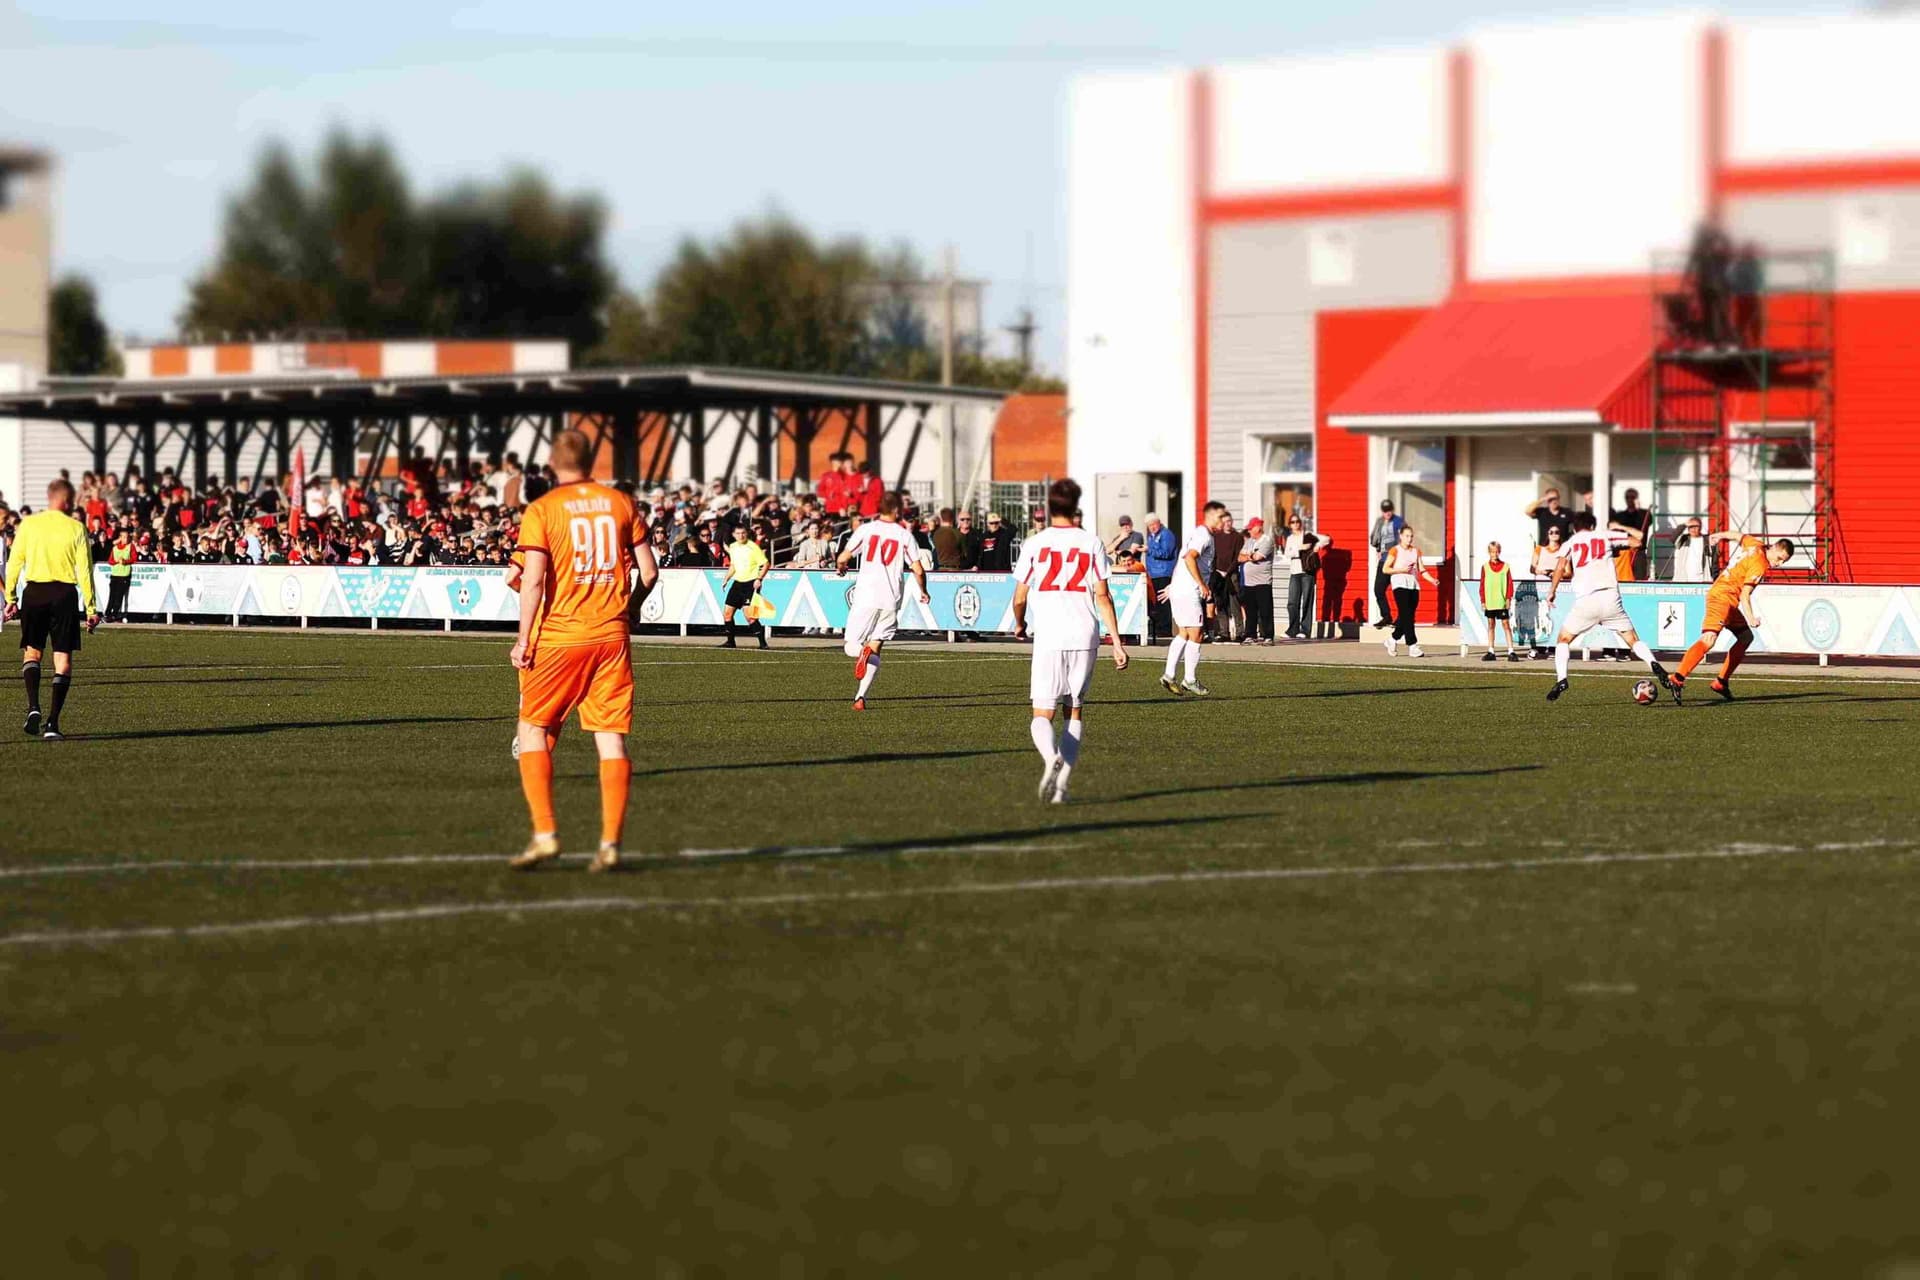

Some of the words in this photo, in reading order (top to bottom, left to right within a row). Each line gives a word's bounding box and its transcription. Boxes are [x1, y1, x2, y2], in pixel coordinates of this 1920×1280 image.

[570, 515, 618, 573] 90
[866, 534, 899, 566] 10
[1573, 538, 1606, 568] 20
[1038, 546, 1090, 593] 22
